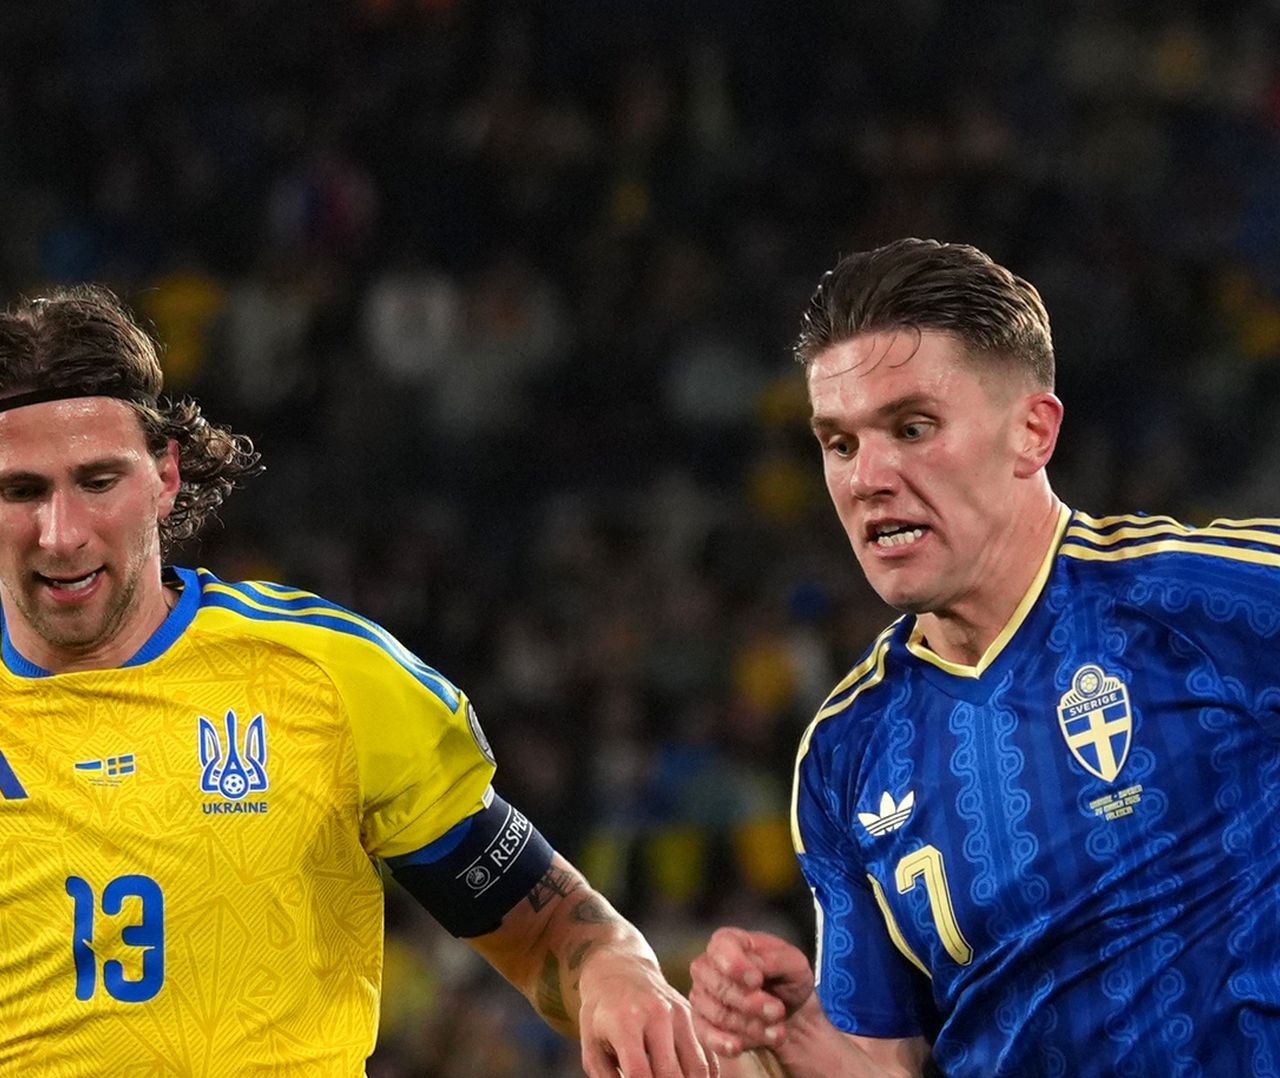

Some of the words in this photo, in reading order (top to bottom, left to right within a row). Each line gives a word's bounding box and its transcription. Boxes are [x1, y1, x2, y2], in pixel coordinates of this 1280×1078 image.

[1069, 693, 1118, 717] SVERIGE
[202, 802, 268, 814] UKRAINE
[490, 807, 529, 867] RESPEC
[65, 874, 165, 1003] 13
